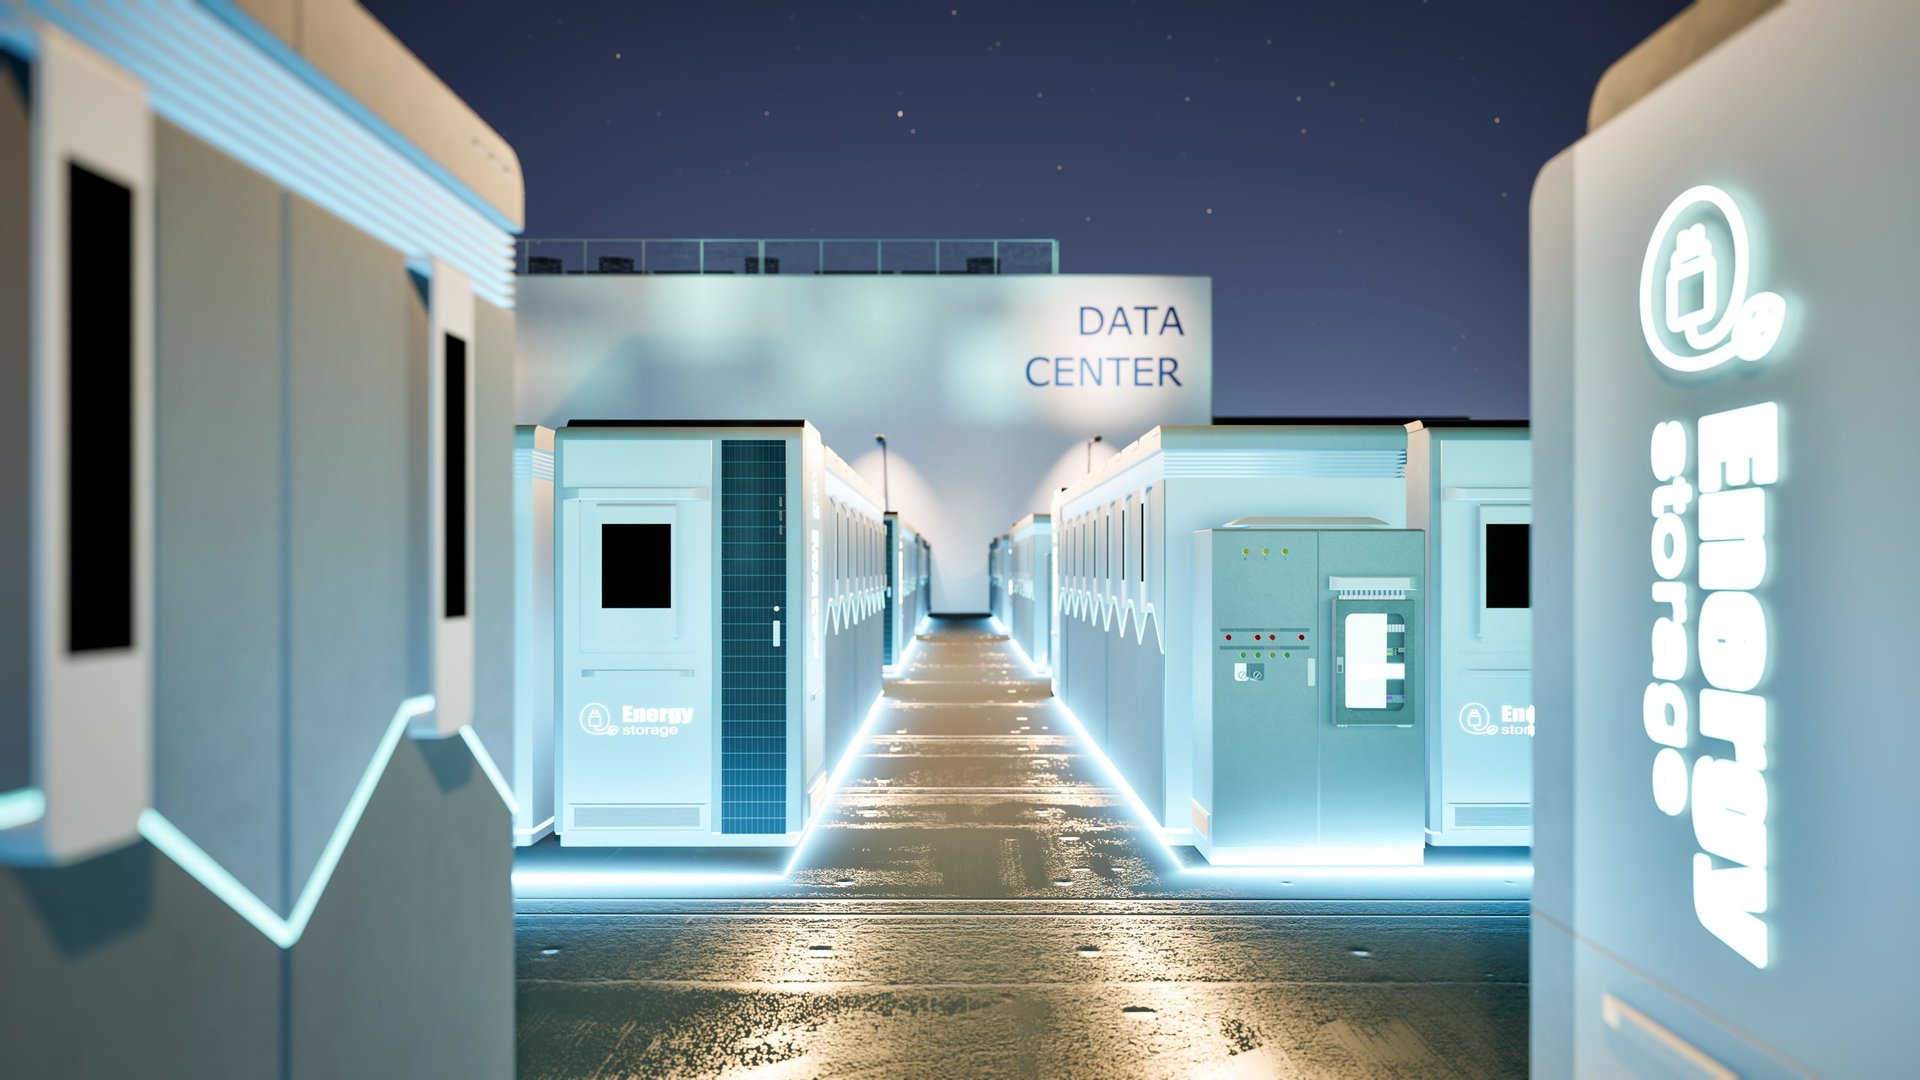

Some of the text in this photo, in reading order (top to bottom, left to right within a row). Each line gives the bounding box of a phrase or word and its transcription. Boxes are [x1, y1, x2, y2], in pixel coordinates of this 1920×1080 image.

[1079, 306, 1185, 336] DATA
[1025, 357, 1183, 388] CENTER
[1643, 420, 1693, 816] storage
[1691, 401, 1779, 969] Energy
[622, 705, 694, 724] Energy
[622, 725, 678, 738] storage
